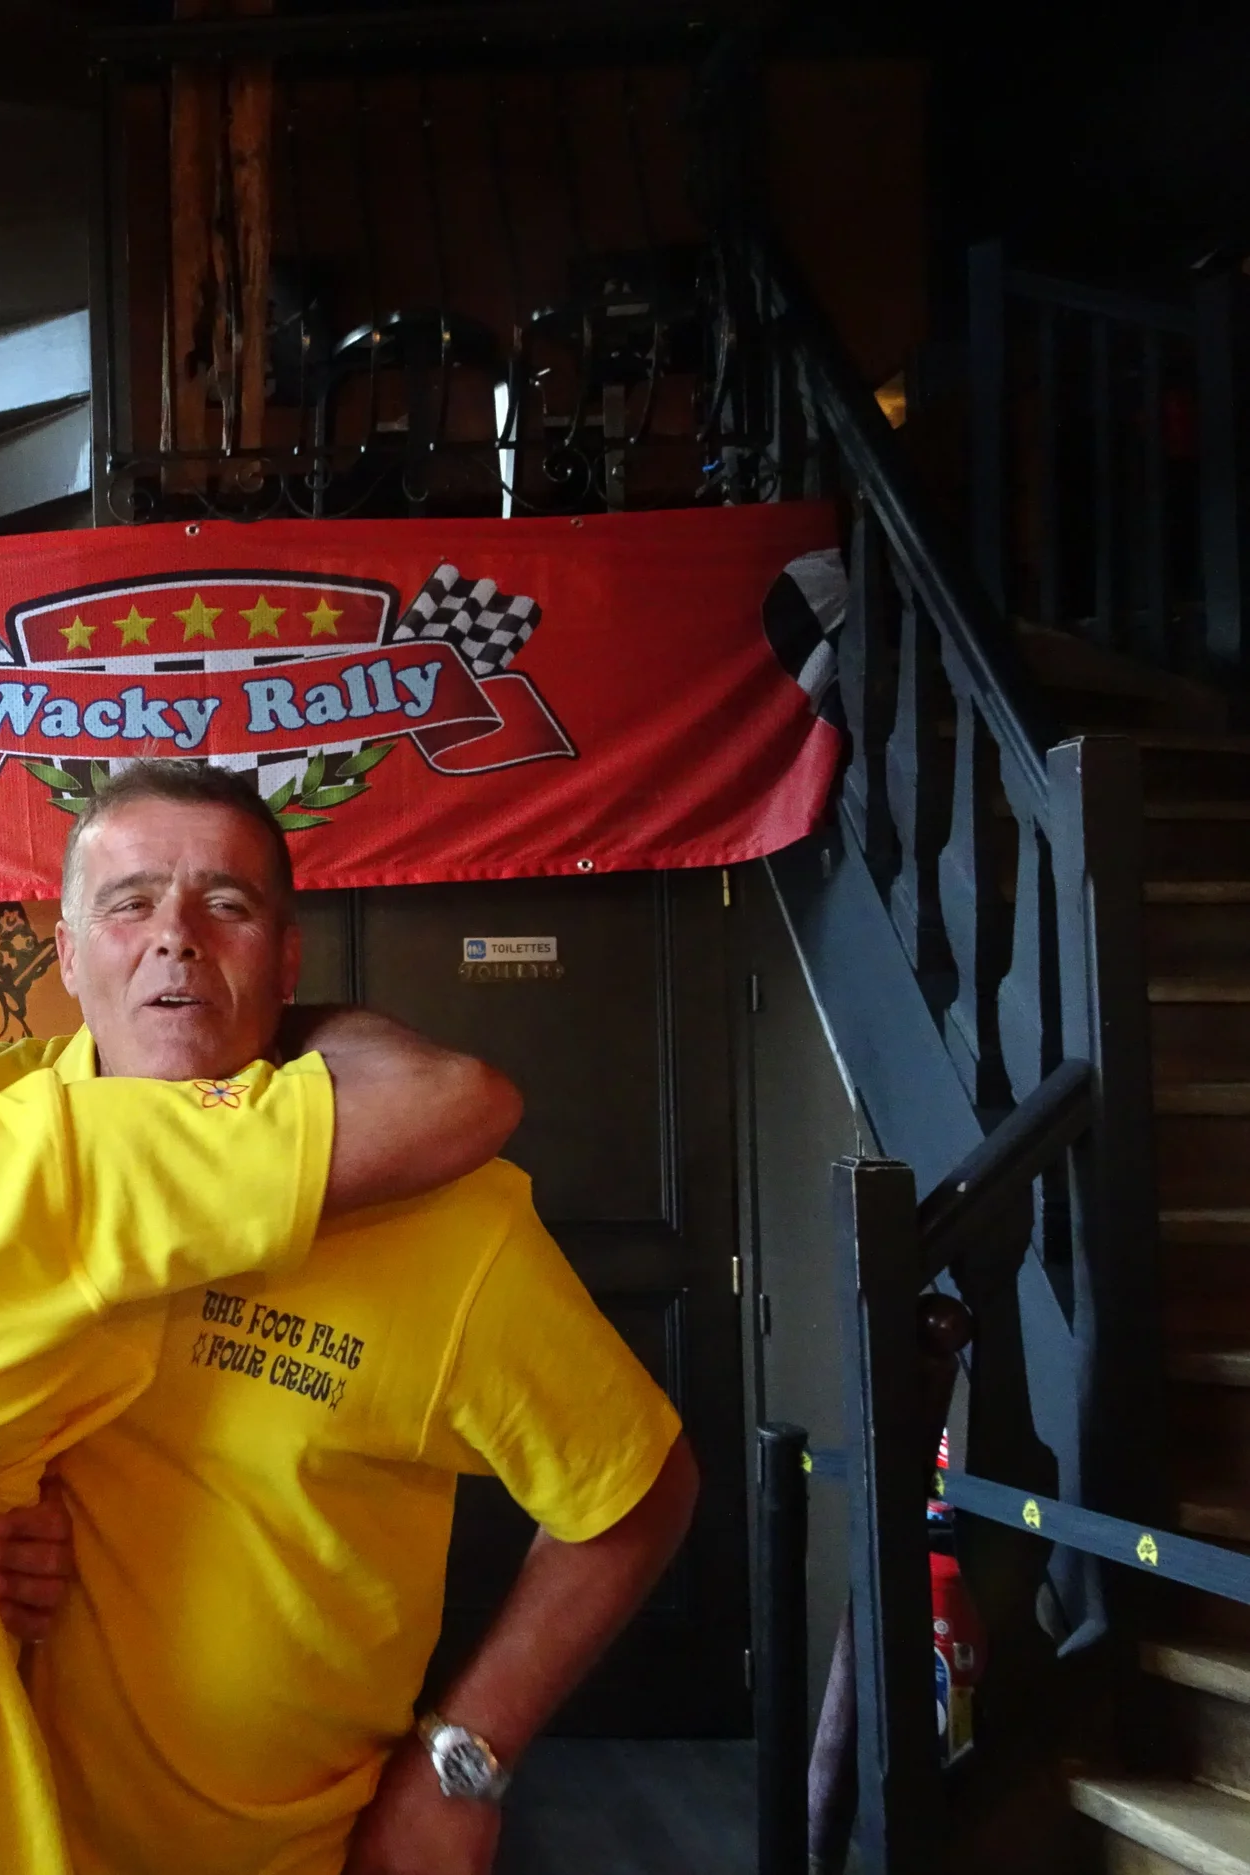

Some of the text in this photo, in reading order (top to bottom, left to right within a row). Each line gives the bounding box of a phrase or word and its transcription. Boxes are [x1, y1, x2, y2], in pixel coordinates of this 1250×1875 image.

[242, 658, 443, 733] Rally
[491, 943, 552, 954] TOILETTES
[202, 1289, 365, 1370] THE FOOT FLAT
[205, 1334, 333, 1402] FOUR CREW
